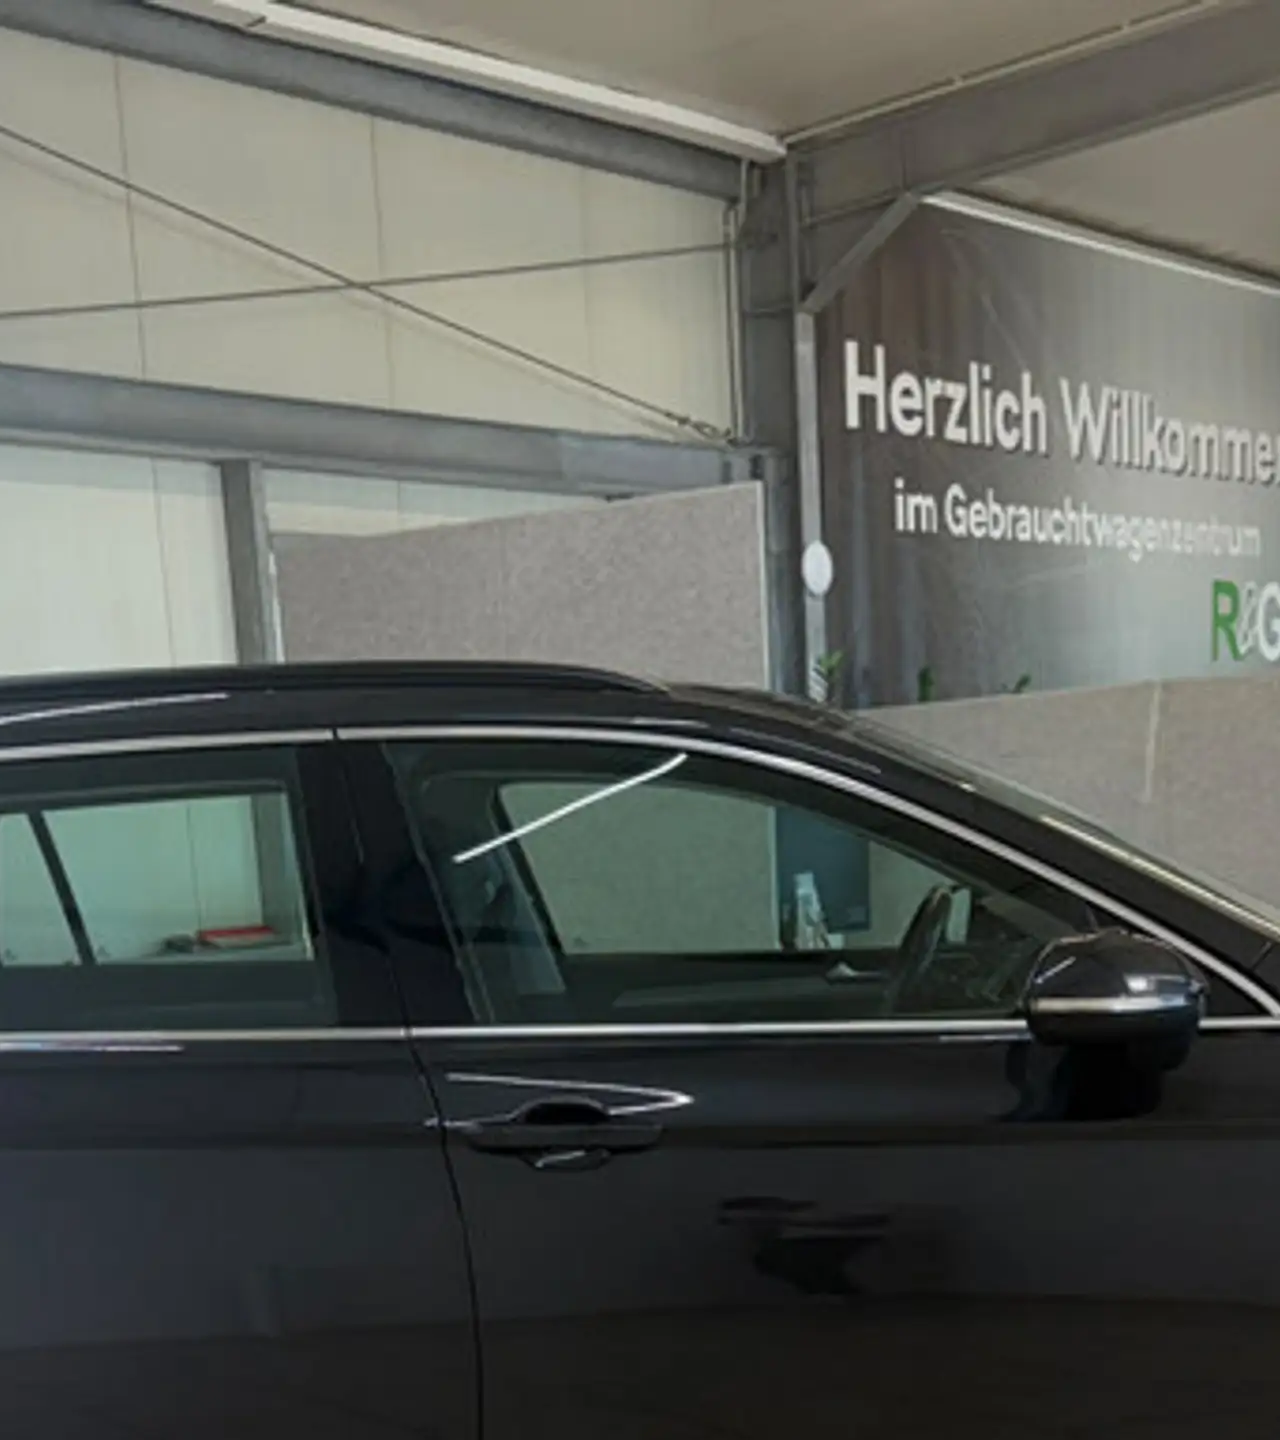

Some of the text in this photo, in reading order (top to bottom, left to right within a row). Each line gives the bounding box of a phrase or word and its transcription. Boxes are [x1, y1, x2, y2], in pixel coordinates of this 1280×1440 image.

[844, 340, 1048, 455] Herzlich
[895, 478, 1260, 562] im Gebrauchtwagenzentrum
